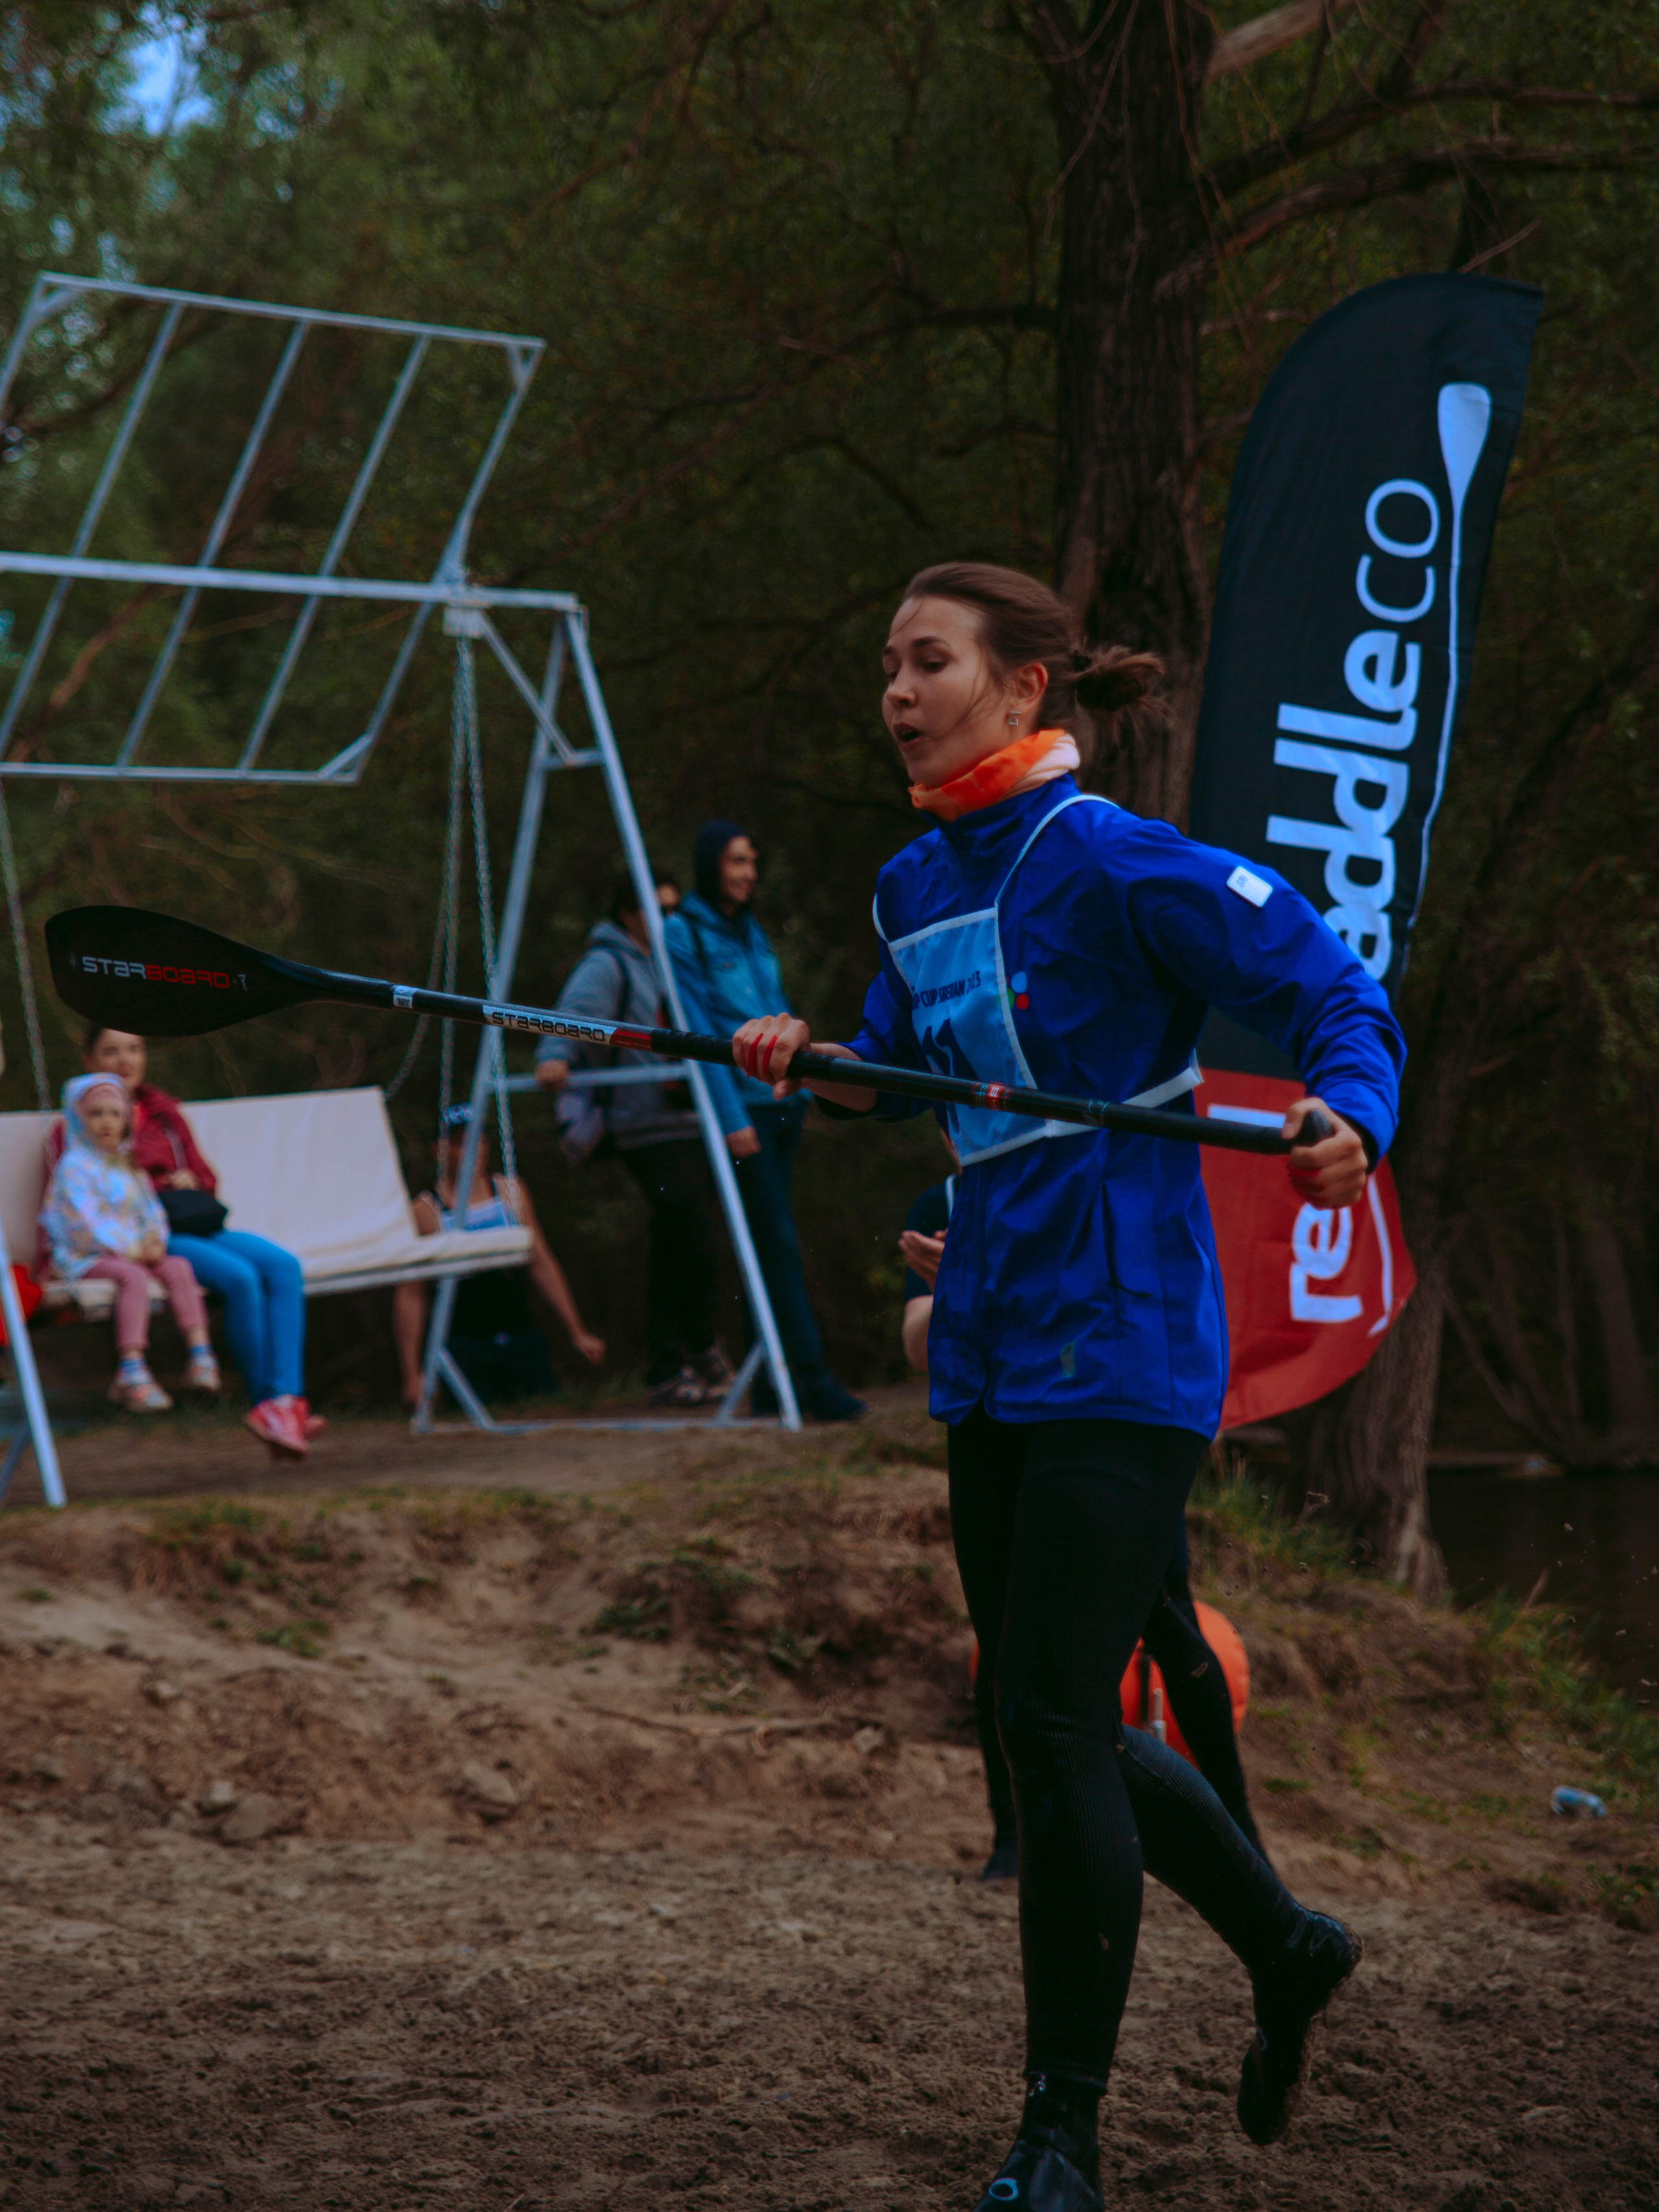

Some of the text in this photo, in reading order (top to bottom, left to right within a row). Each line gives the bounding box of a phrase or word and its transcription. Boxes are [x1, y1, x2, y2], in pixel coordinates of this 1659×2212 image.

[1265, 478, 1441, 981] addleco
[82, 955, 229, 988] STARBOARD
[920, 988, 938, 1007] CUP
[492, 1012, 605, 1042] STARBOARD
